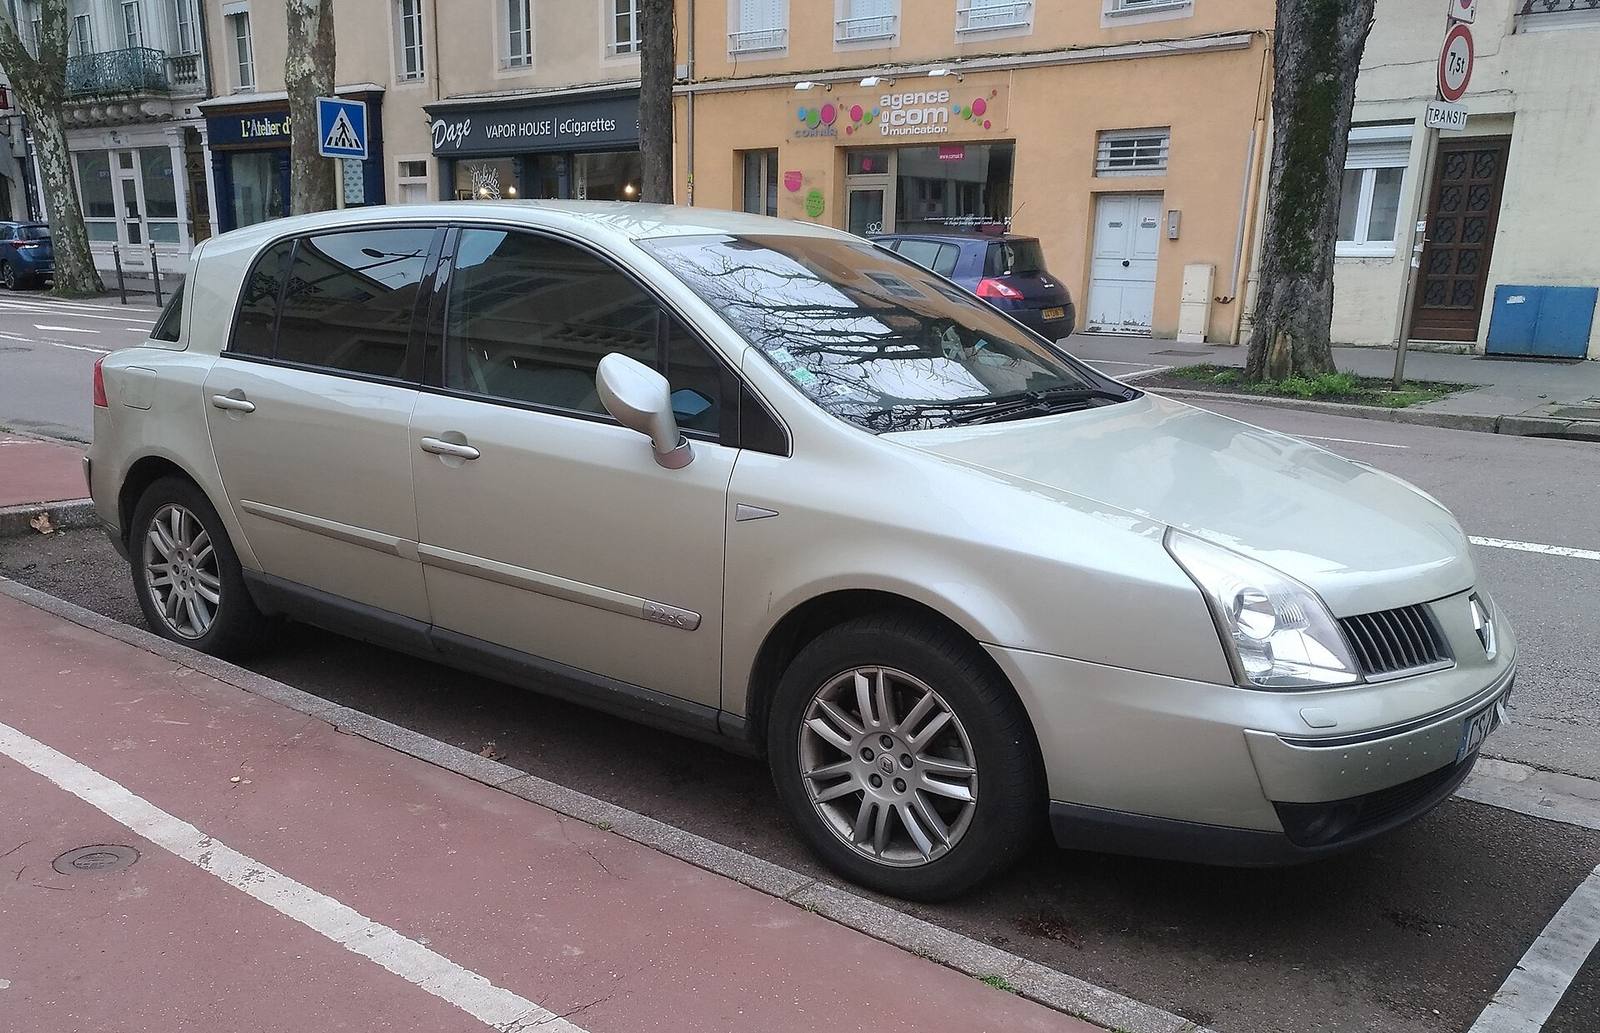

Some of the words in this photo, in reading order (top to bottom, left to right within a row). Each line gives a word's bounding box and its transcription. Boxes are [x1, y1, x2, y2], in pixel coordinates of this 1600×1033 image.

[1448, 52, 1466, 75] 7,5t
[879, 90, 950, 110] agence
[890, 107, 949, 126] com
[1428, 108, 1468, 125] TRANSIT
[241, 117, 281, 137] L'Atelier
[431, 118, 472, 149] Daze
[485, 123, 516, 138] VAPOR
[518, 120, 551, 136] HOUSE
[559, 118, 616, 136] eCigarettes
[889, 124, 948, 136] munication
